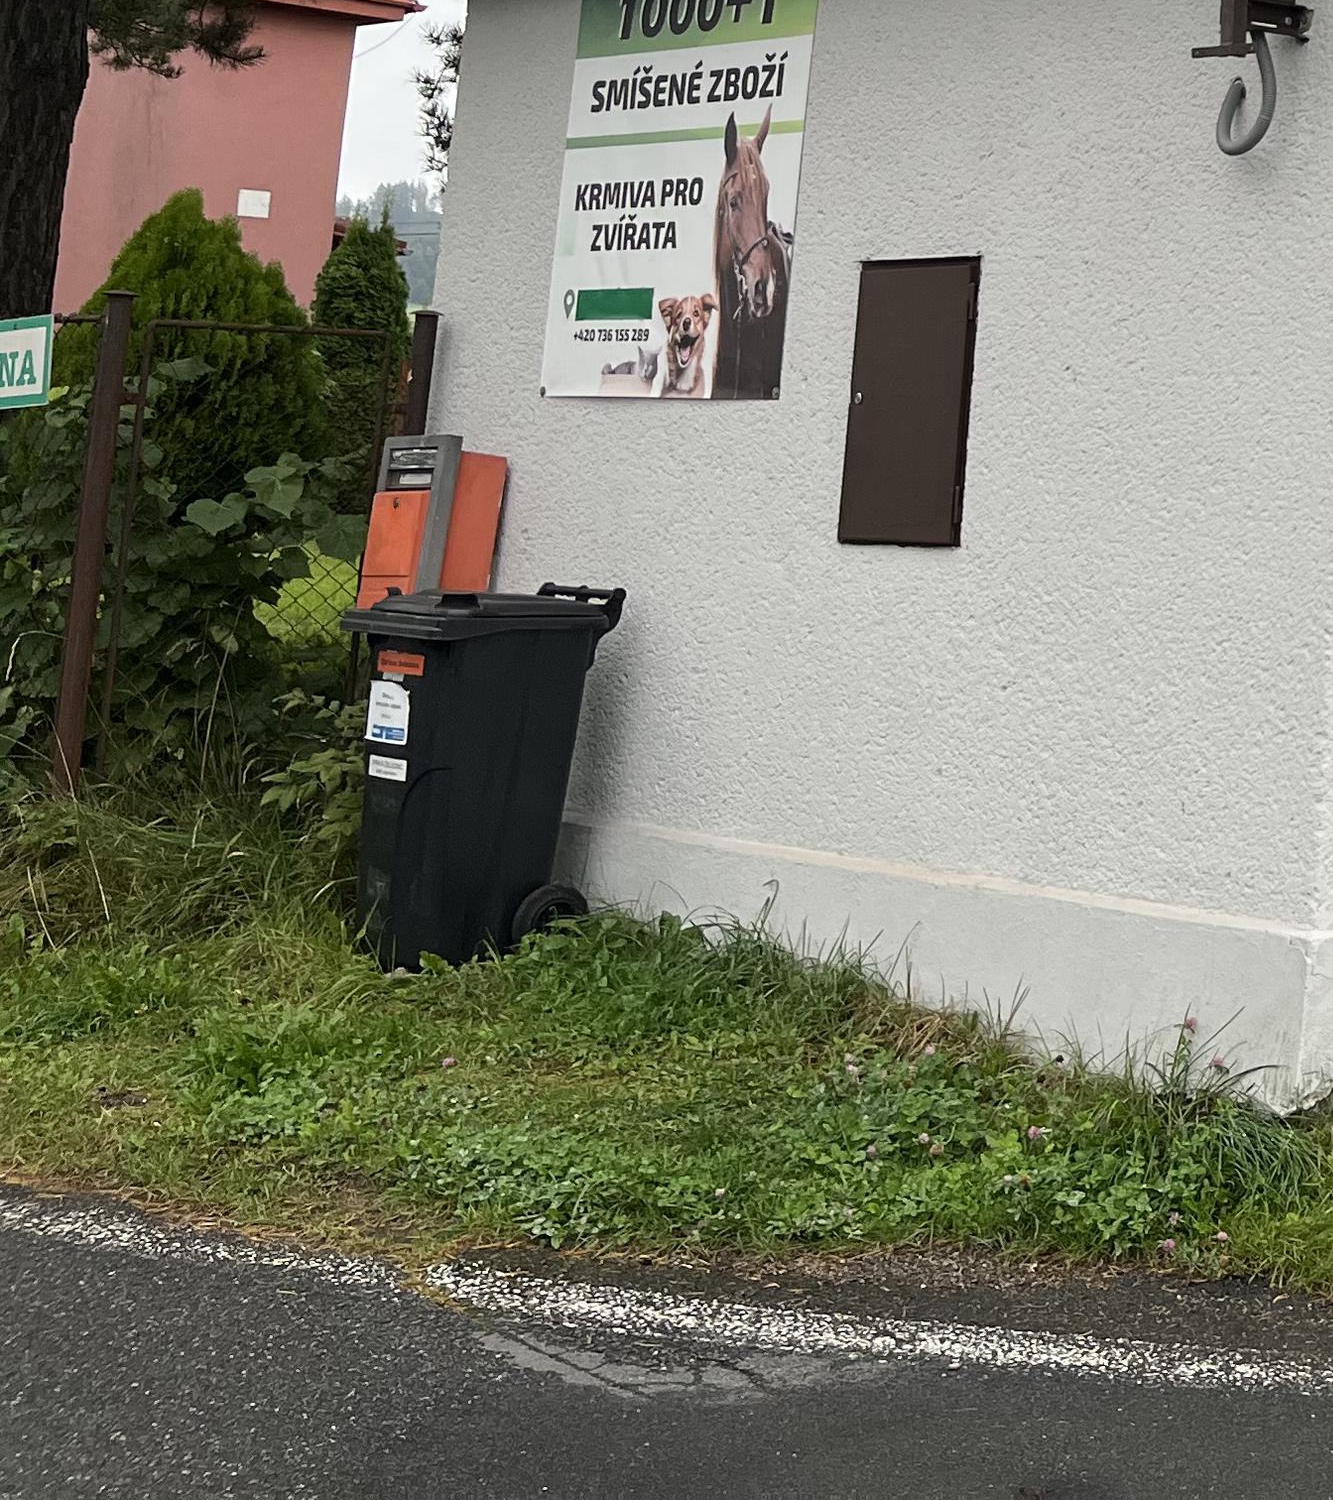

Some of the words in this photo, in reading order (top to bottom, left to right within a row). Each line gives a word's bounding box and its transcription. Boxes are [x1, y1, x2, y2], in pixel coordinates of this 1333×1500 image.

[590, 59, 704, 114] SMÍŠENÉ
[706, 50, 789, 100] ZBOŽÍ
[574, 180, 656, 212] KRMIVA
[659, 176, 704, 207] PRO
[589, 214, 677, 252] ZVÍŘATA
[573, 328, 595, 342] +420
[597, 328, 613, 342] 736
[614, 328, 630, 342] 155
[631, 328, 650, 342] 289
